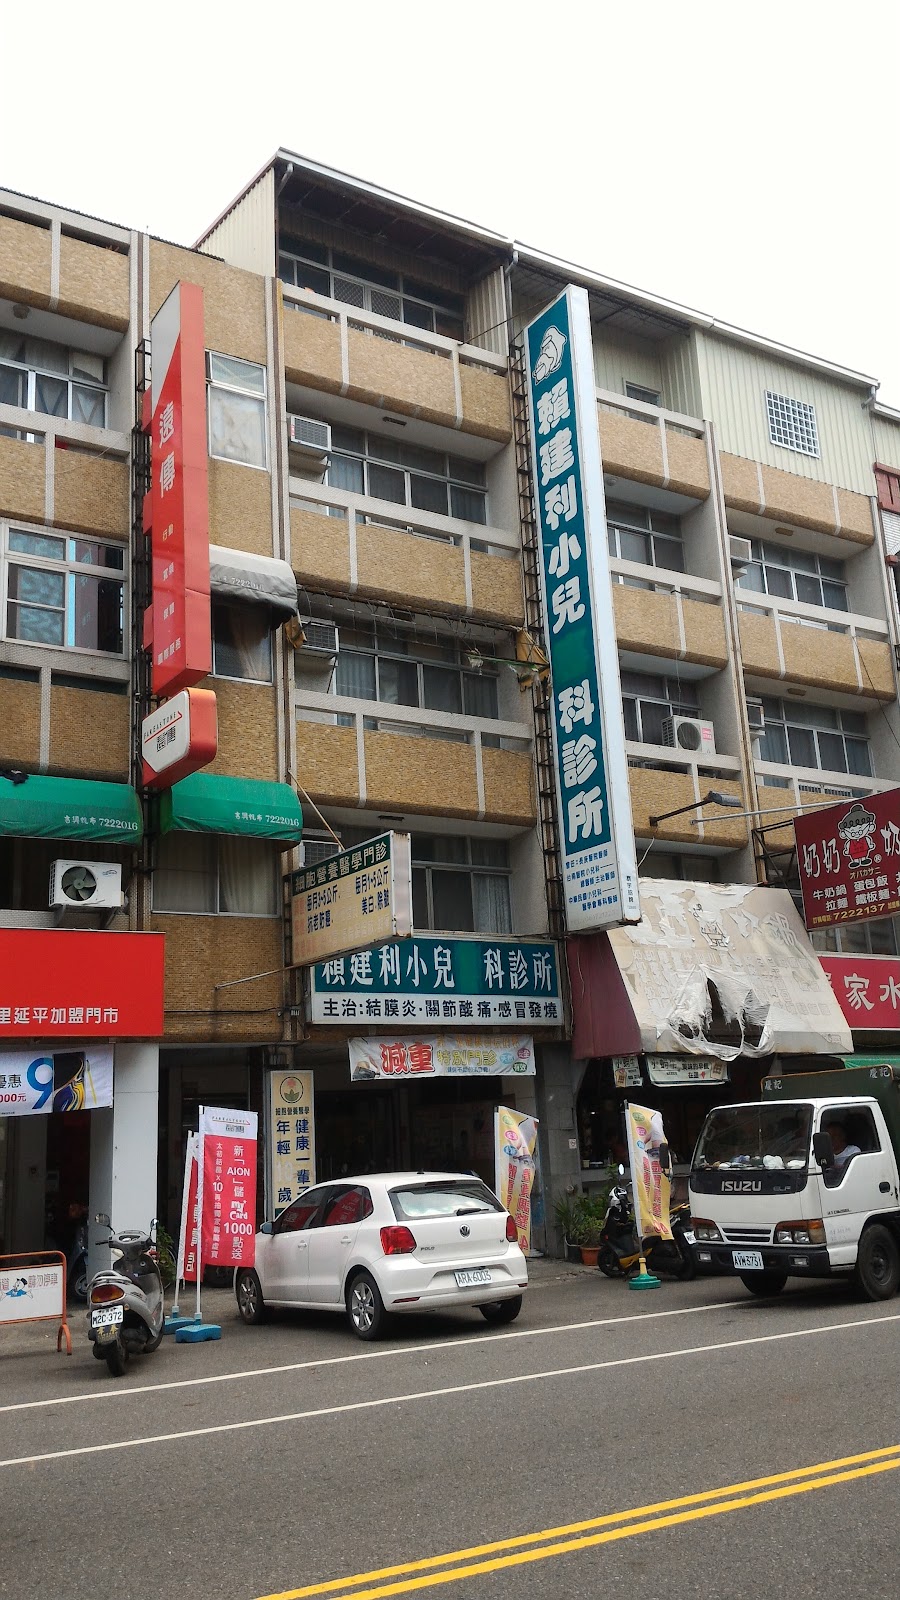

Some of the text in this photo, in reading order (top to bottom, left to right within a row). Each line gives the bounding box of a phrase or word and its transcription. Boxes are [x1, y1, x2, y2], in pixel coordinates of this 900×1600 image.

[535, 377, 605, 842] 賴建利小兒 科診所
[98, 817, 138, 831] 7222016
[265, 814, 300, 827] 7222016
[803, 838, 841, 878] 奶奶
[813, 884, 847, 900] 牛奶鍋
[853, 875, 889, 892] 蛋包飯
[833, 903, 885, 920] 7222137
[483, 948, 553, 991] 科診所
[825, 971, 900, 1011] 家水
[379, 1042, 435, 1076] 減重
[436, 1049, 498, 1067] 特別門診
[26, 1057, 54, 1110] 9
[227, 1167, 250, 1176] AION
[720, 1181, 762, 1192] ISUZU
[224, 1222, 253, 1236] 1000
